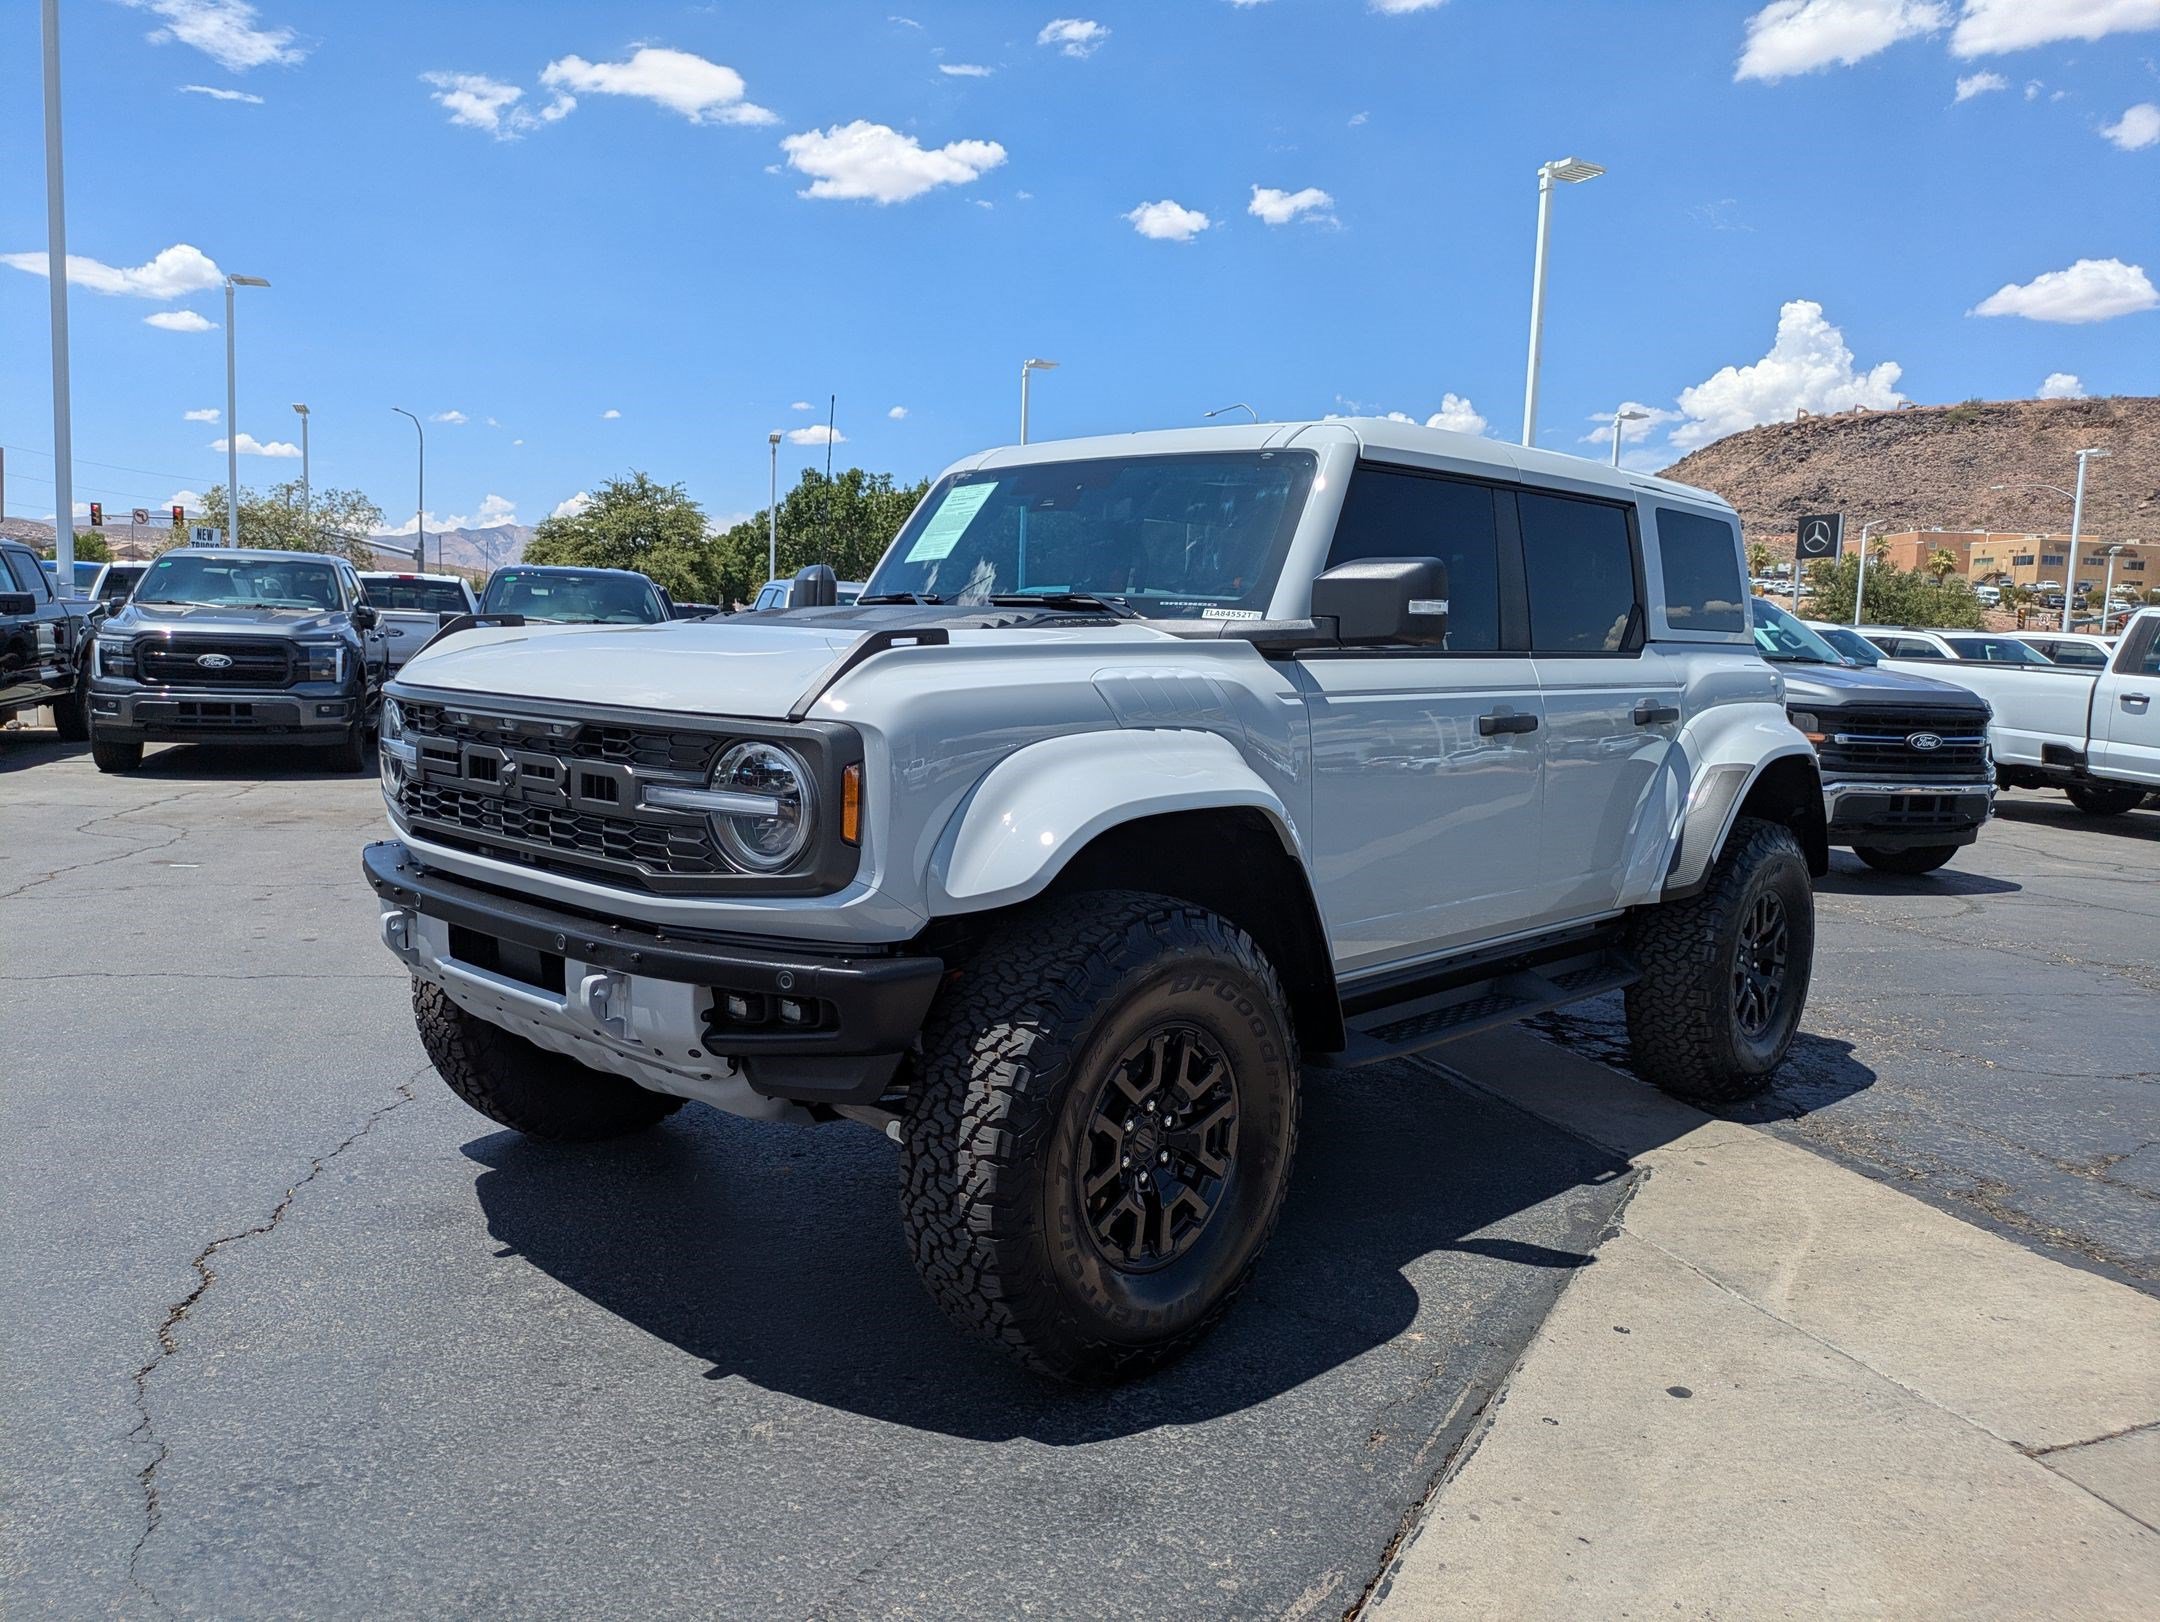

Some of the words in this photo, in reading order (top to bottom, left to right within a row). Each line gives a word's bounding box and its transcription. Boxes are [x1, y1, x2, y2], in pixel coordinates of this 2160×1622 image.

[197, 528, 213, 541] NEW
[1204, 609, 1253, 619] TLA84552T
[416, 736, 635, 818] FORD
